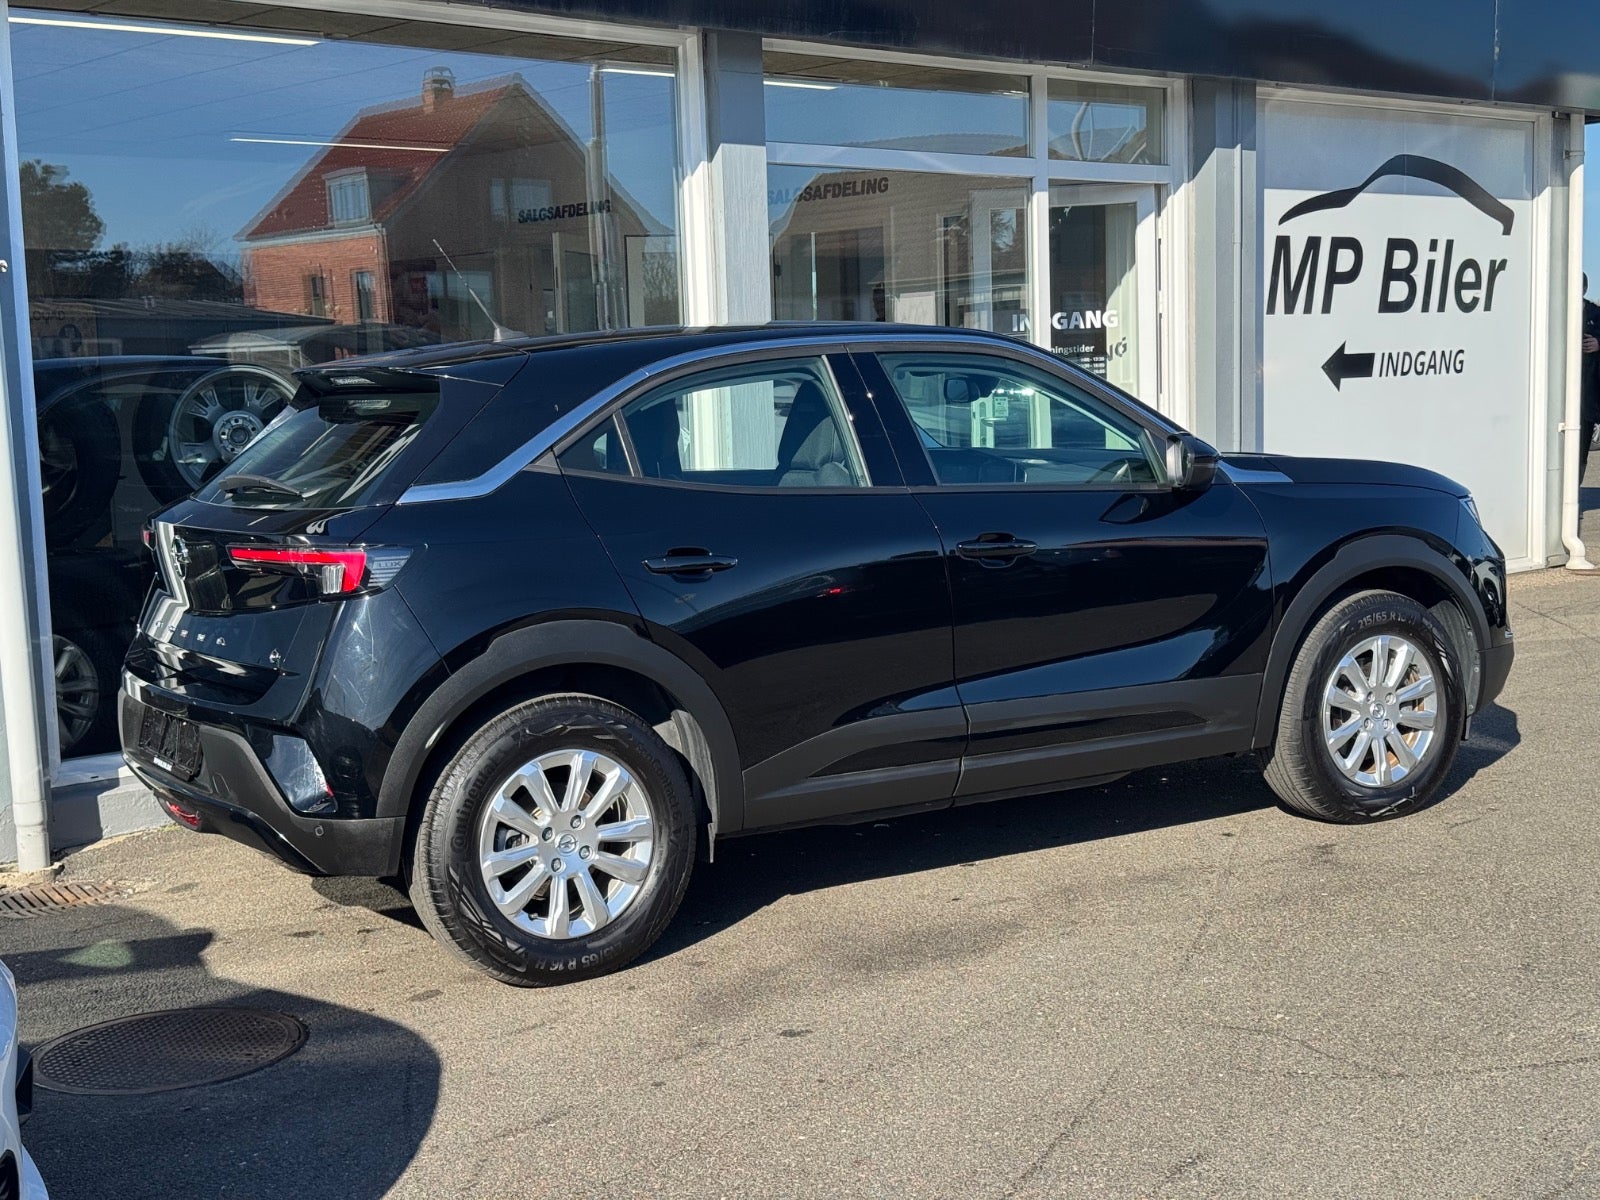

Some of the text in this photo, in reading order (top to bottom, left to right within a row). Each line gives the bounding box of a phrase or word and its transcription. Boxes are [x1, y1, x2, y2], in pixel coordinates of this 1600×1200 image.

[768, 176, 889, 205] SALGSAFDELING
[518, 199, 611, 223] SALGSAFDELING
[1265, 235, 1508, 315] MP Biler
[1012, 309, 1119, 332] INGANG
[1378, 349, 1465, 377] INDGANG
[1358, 611, 1387, 629] 215/65
